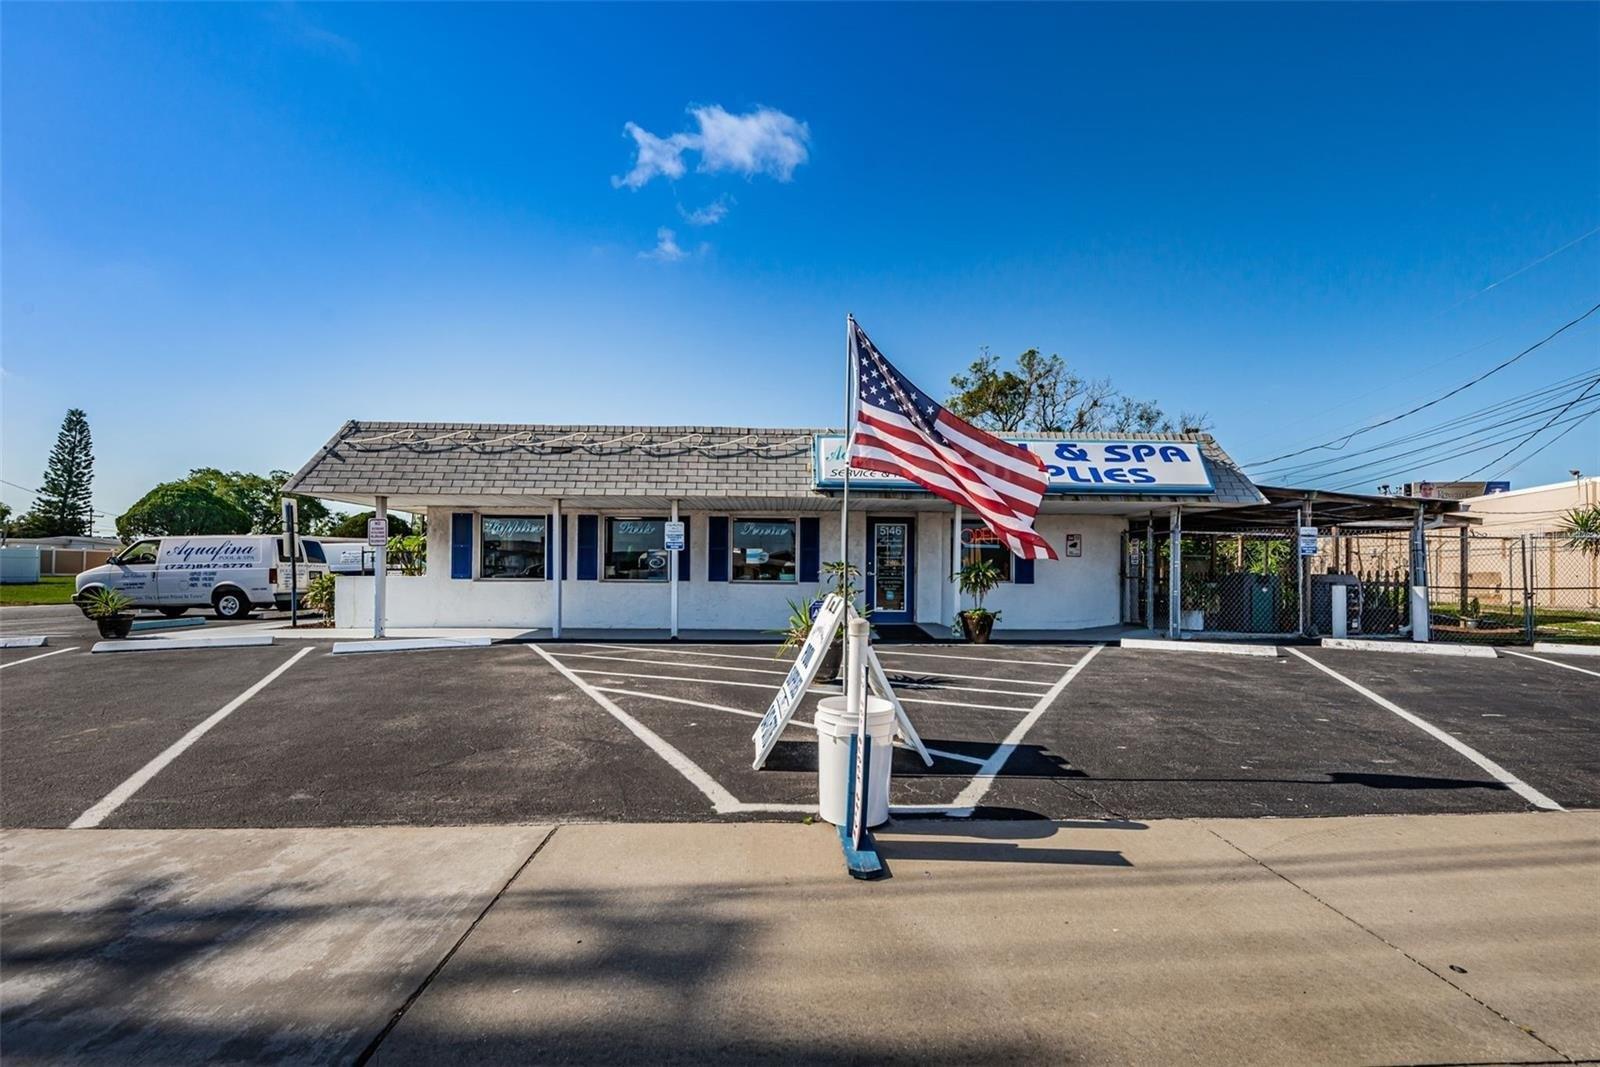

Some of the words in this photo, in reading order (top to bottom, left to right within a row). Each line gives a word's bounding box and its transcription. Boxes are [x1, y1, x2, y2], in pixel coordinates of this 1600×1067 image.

[1055, 443, 1091, 462] &
[1104, 444, 1191, 463] SPA
[1045, 464, 1157, 484] PLIES
[879, 526, 902, 536] 5146
[166, 539, 255, 562] Aquafina
